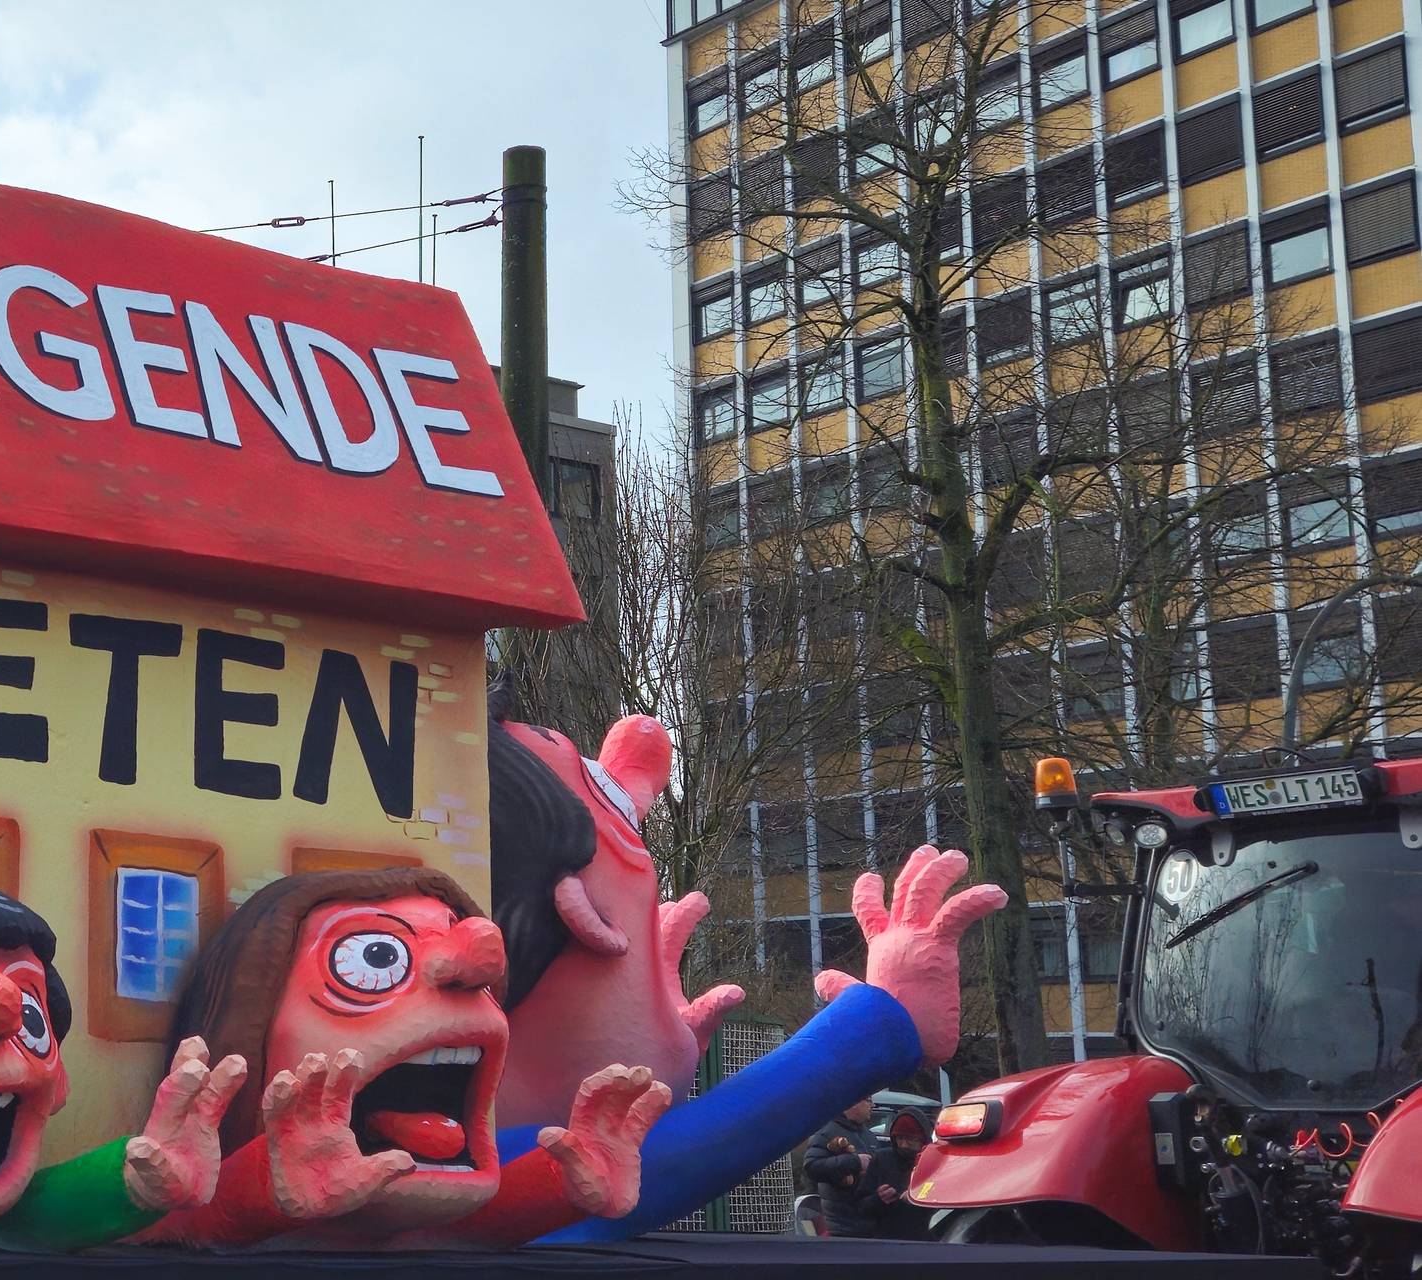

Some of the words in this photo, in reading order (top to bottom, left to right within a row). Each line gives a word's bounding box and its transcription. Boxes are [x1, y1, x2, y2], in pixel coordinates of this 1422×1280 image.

[1225, 783, 1269, 809] WES
[1281, 778, 1310, 804] LT
[1315, 773, 1359, 800] 145
[1166, 859, 1193, 894] 50
